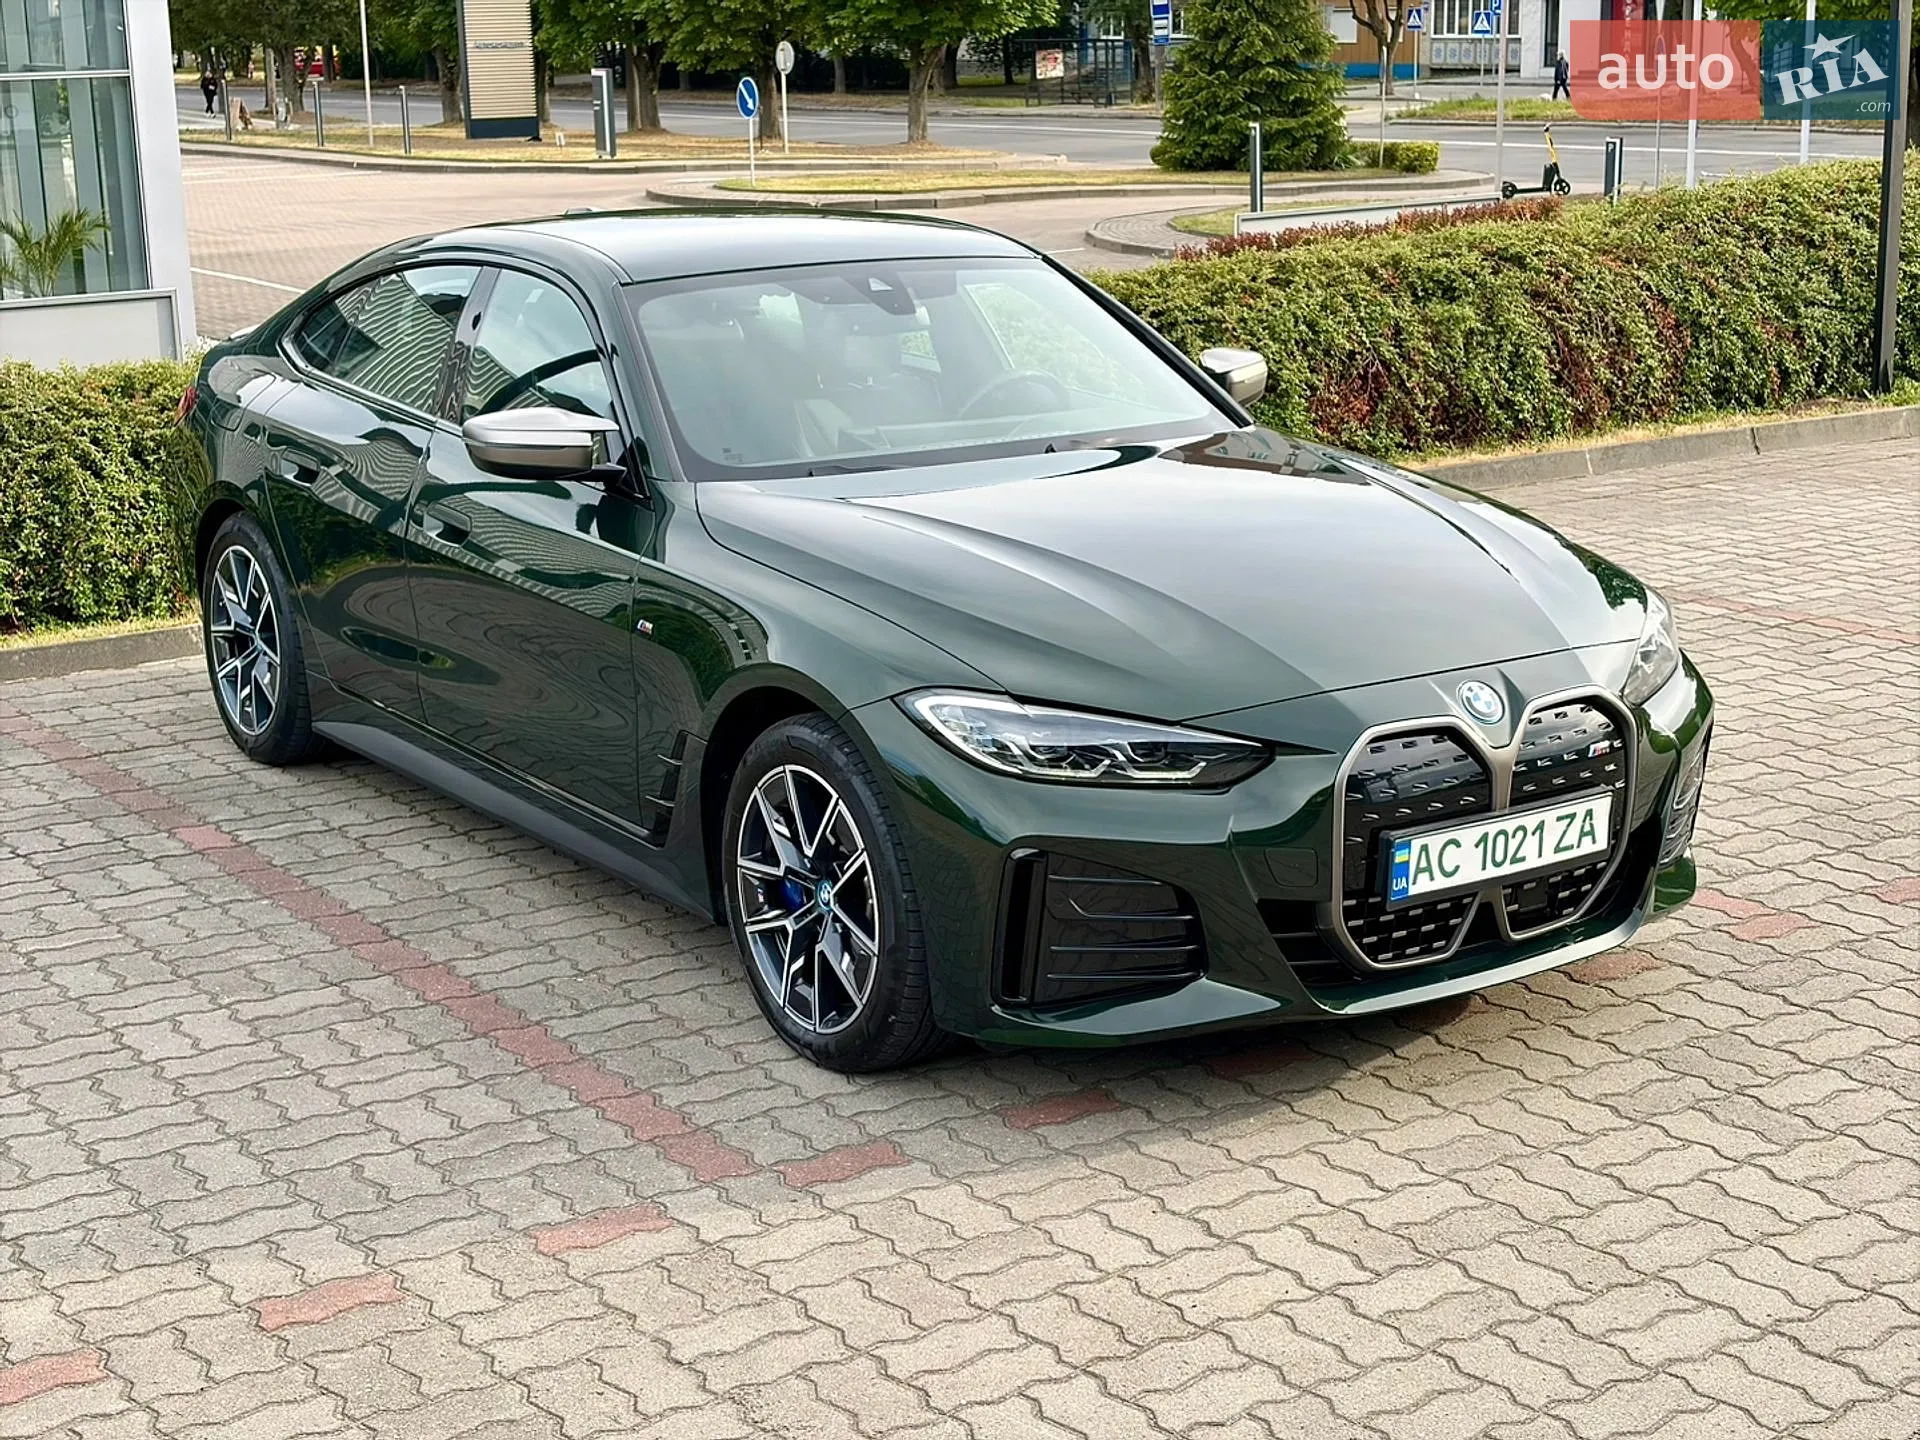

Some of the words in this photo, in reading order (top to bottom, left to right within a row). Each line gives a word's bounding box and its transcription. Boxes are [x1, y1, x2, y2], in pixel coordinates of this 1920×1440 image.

[1412, 838, 1462, 885] AC
[1474, 819, 1546, 871] 1021
[1553, 808, 1597, 854] ZA
[1392, 878, 1408, 890] UA
